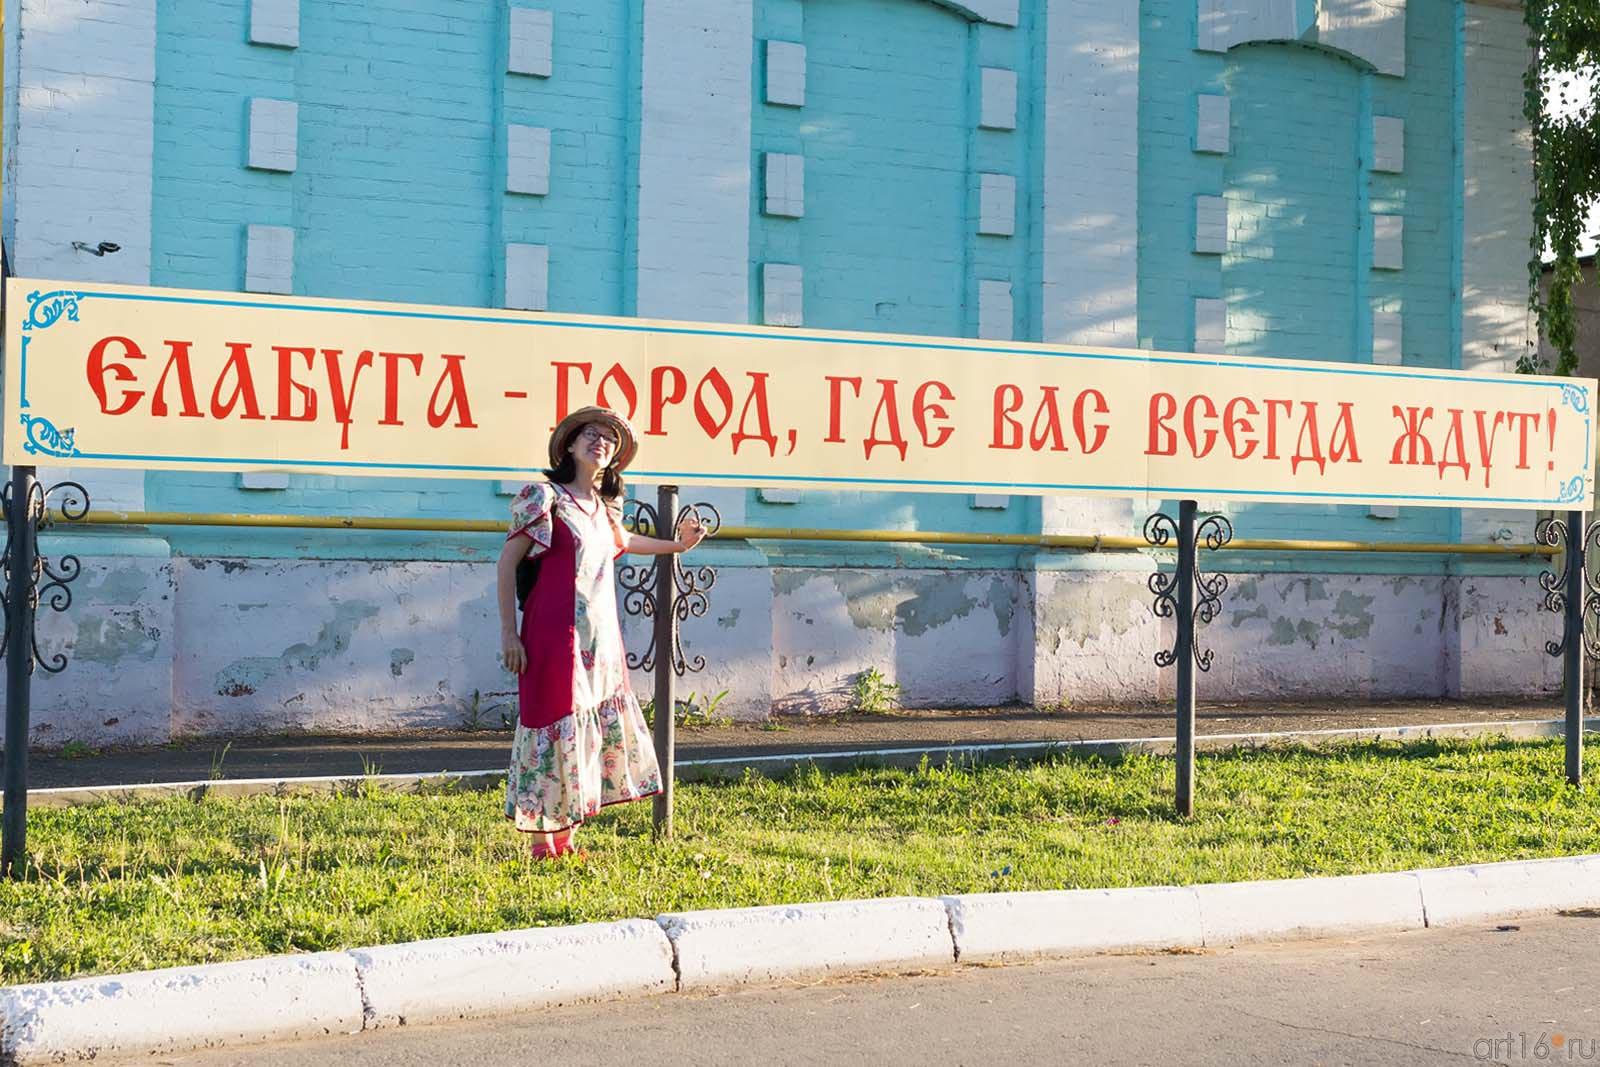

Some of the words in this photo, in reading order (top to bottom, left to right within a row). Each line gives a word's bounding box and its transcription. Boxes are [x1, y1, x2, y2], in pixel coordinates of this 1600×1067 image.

[86, 335, 478, 450] ЕЛАБУГА
[549, 361, 798, 458] ГОРОД,
[824, 375, 955, 461] ГДЕ
[989, 383, 1111, 455] ВАС
[1145, 391, 1362, 475] ВСЕГДА
[1389, 406, 1557, 488] ЖДУТ!
